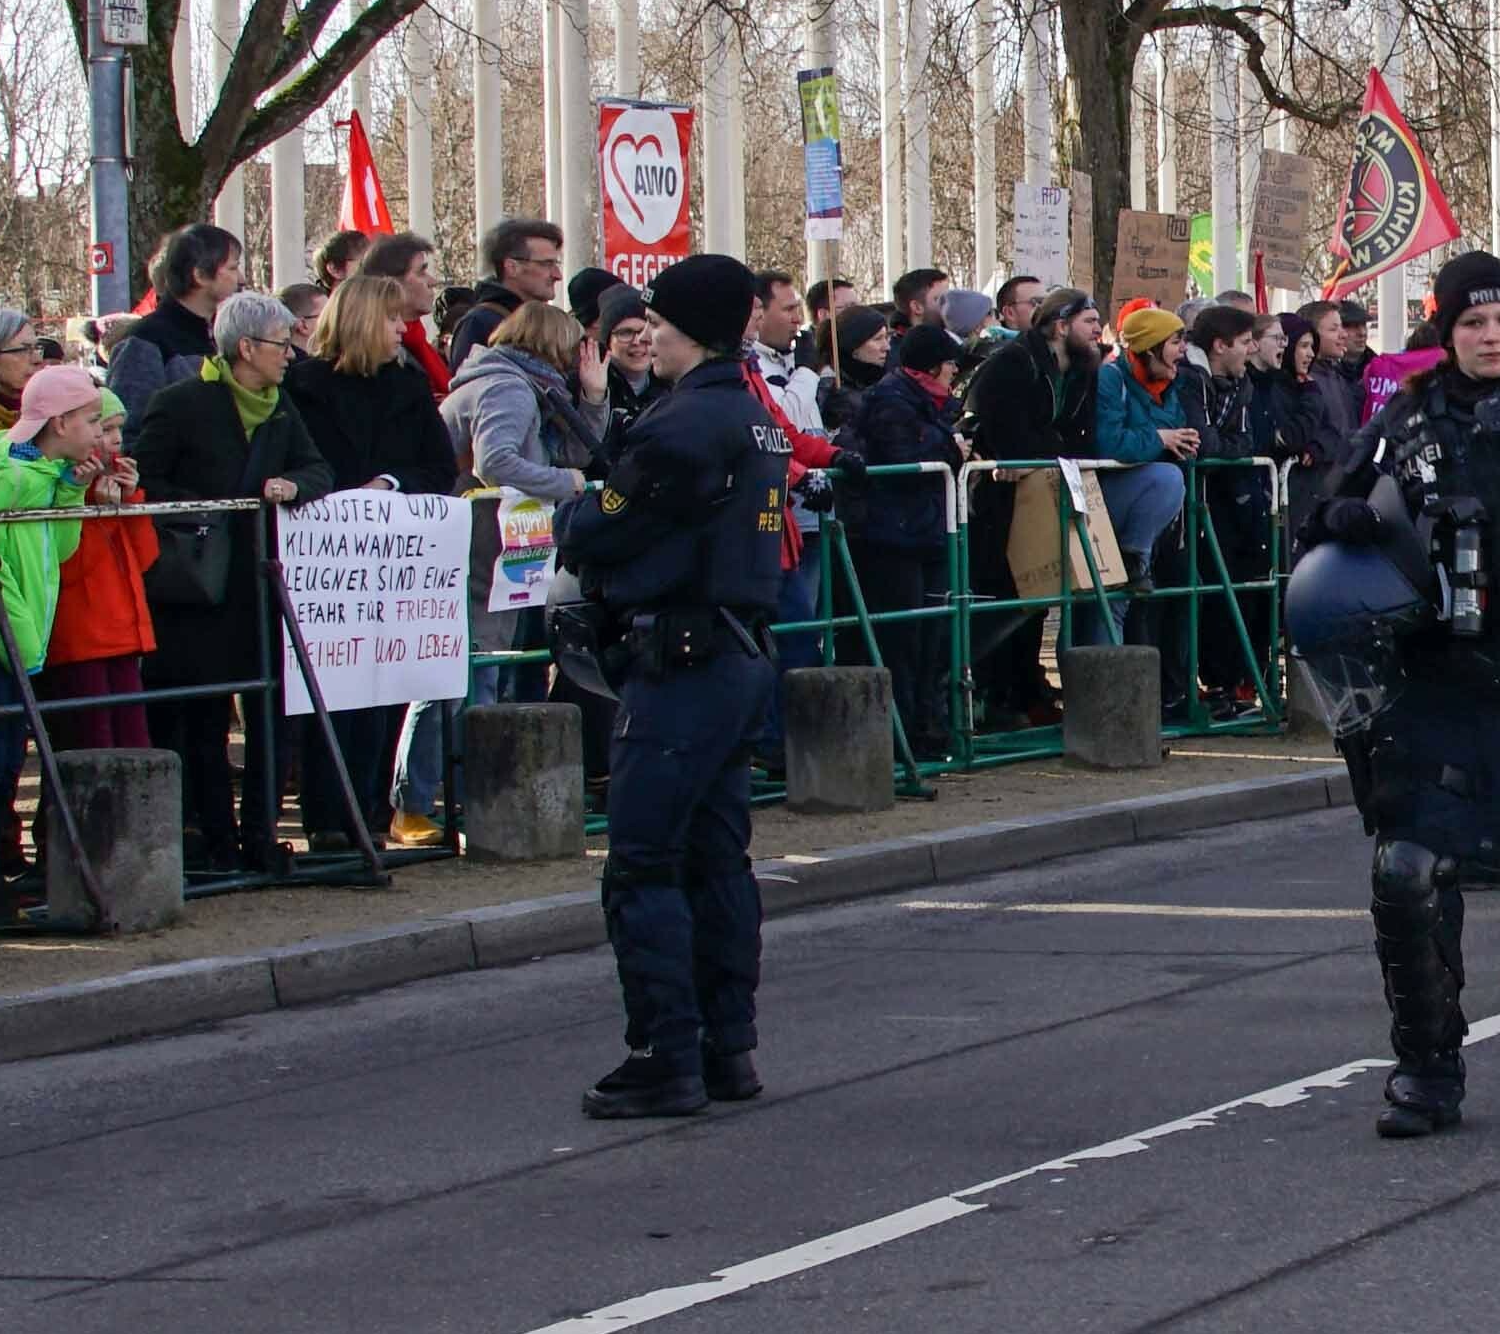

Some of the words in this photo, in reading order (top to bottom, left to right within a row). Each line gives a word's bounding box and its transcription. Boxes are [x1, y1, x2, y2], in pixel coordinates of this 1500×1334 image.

[634, 165, 677, 197] AWO
[752, 425, 794, 453] POLIZE
[406, 496, 449, 522] UND
[285, 566, 369, 592] LEUGNER
[378, 565, 416, 592] SIND
[423, 567, 461, 593] EINE
[298, 602, 346, 624] EFAHR
[357, 599, 385, 624] FÜR
[375, 636, 407, 665] UND
[417, 632, 464, 661] LEBEN
